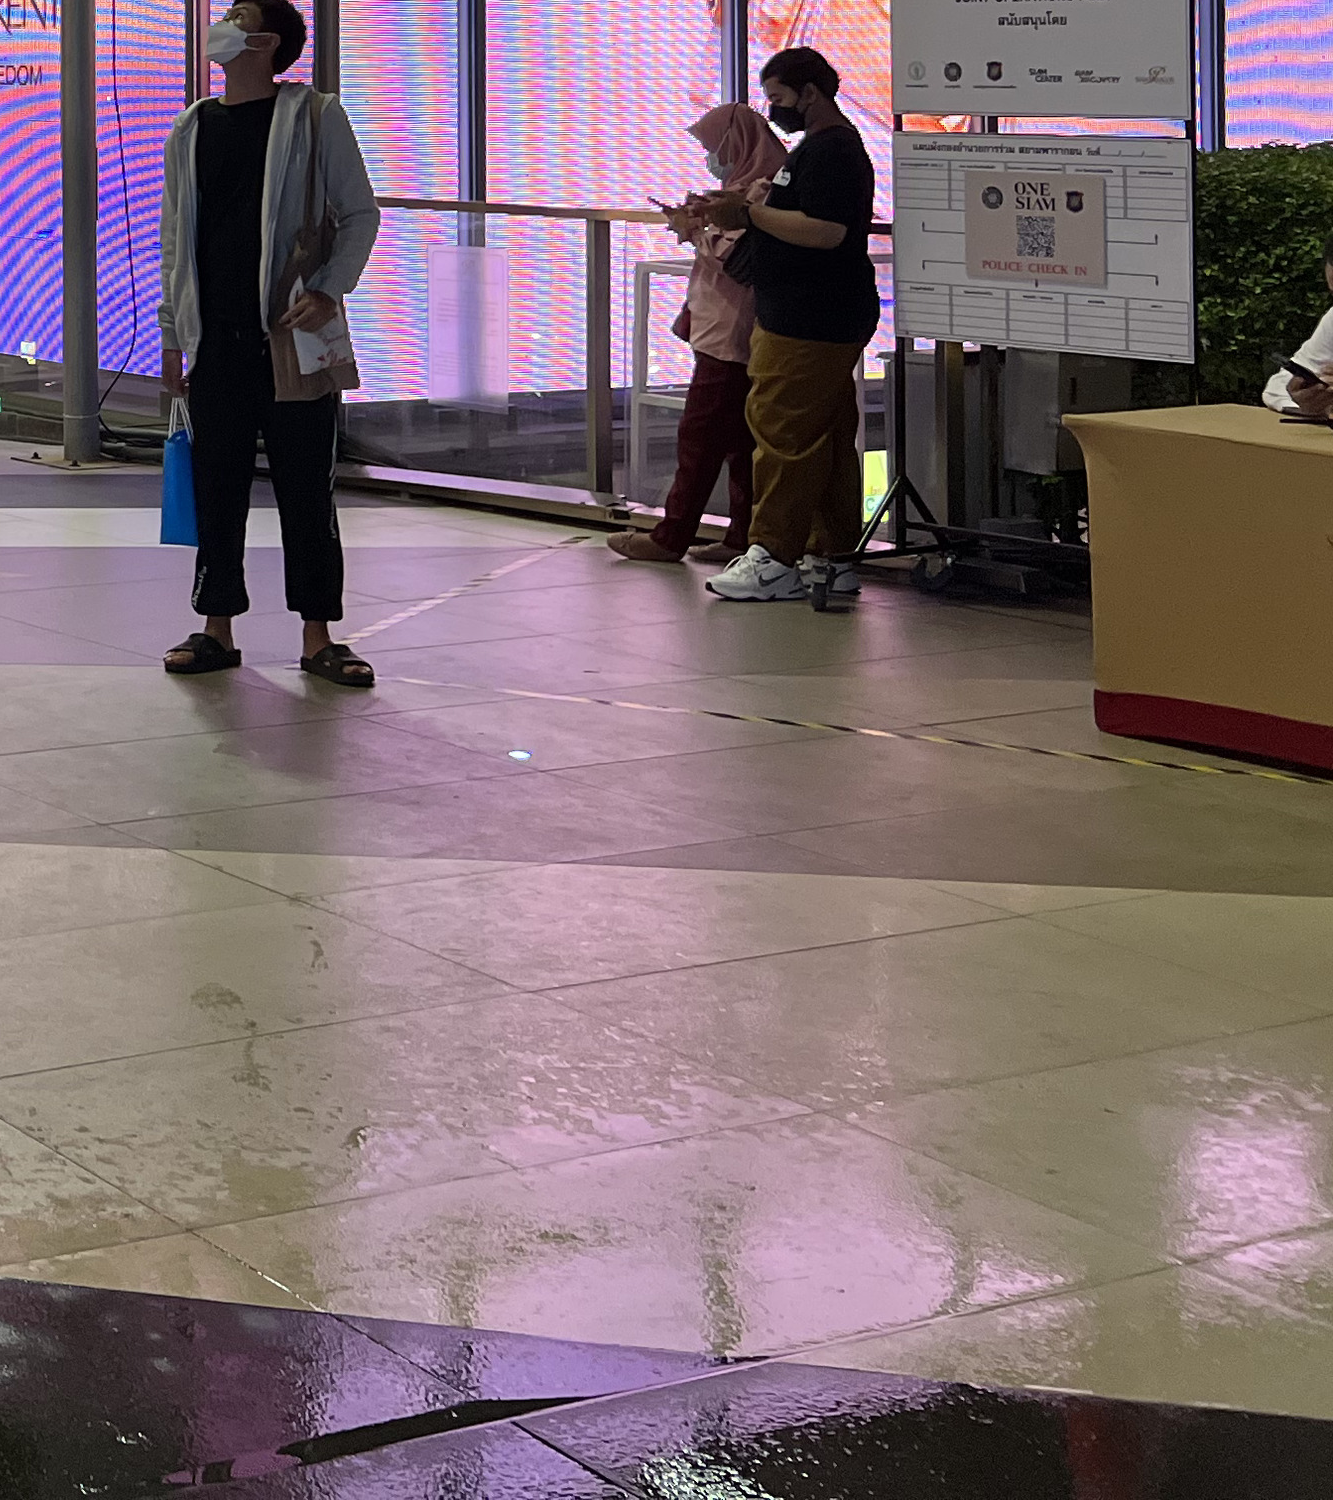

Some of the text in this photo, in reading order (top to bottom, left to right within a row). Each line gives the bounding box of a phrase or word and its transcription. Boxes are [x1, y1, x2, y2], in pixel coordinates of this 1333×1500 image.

[1014, 181, 1051, 197] ONE
[1015, 197, 1056, 212] SIAM
[982, 260, 1088, 277] POLICE CHECK IN
